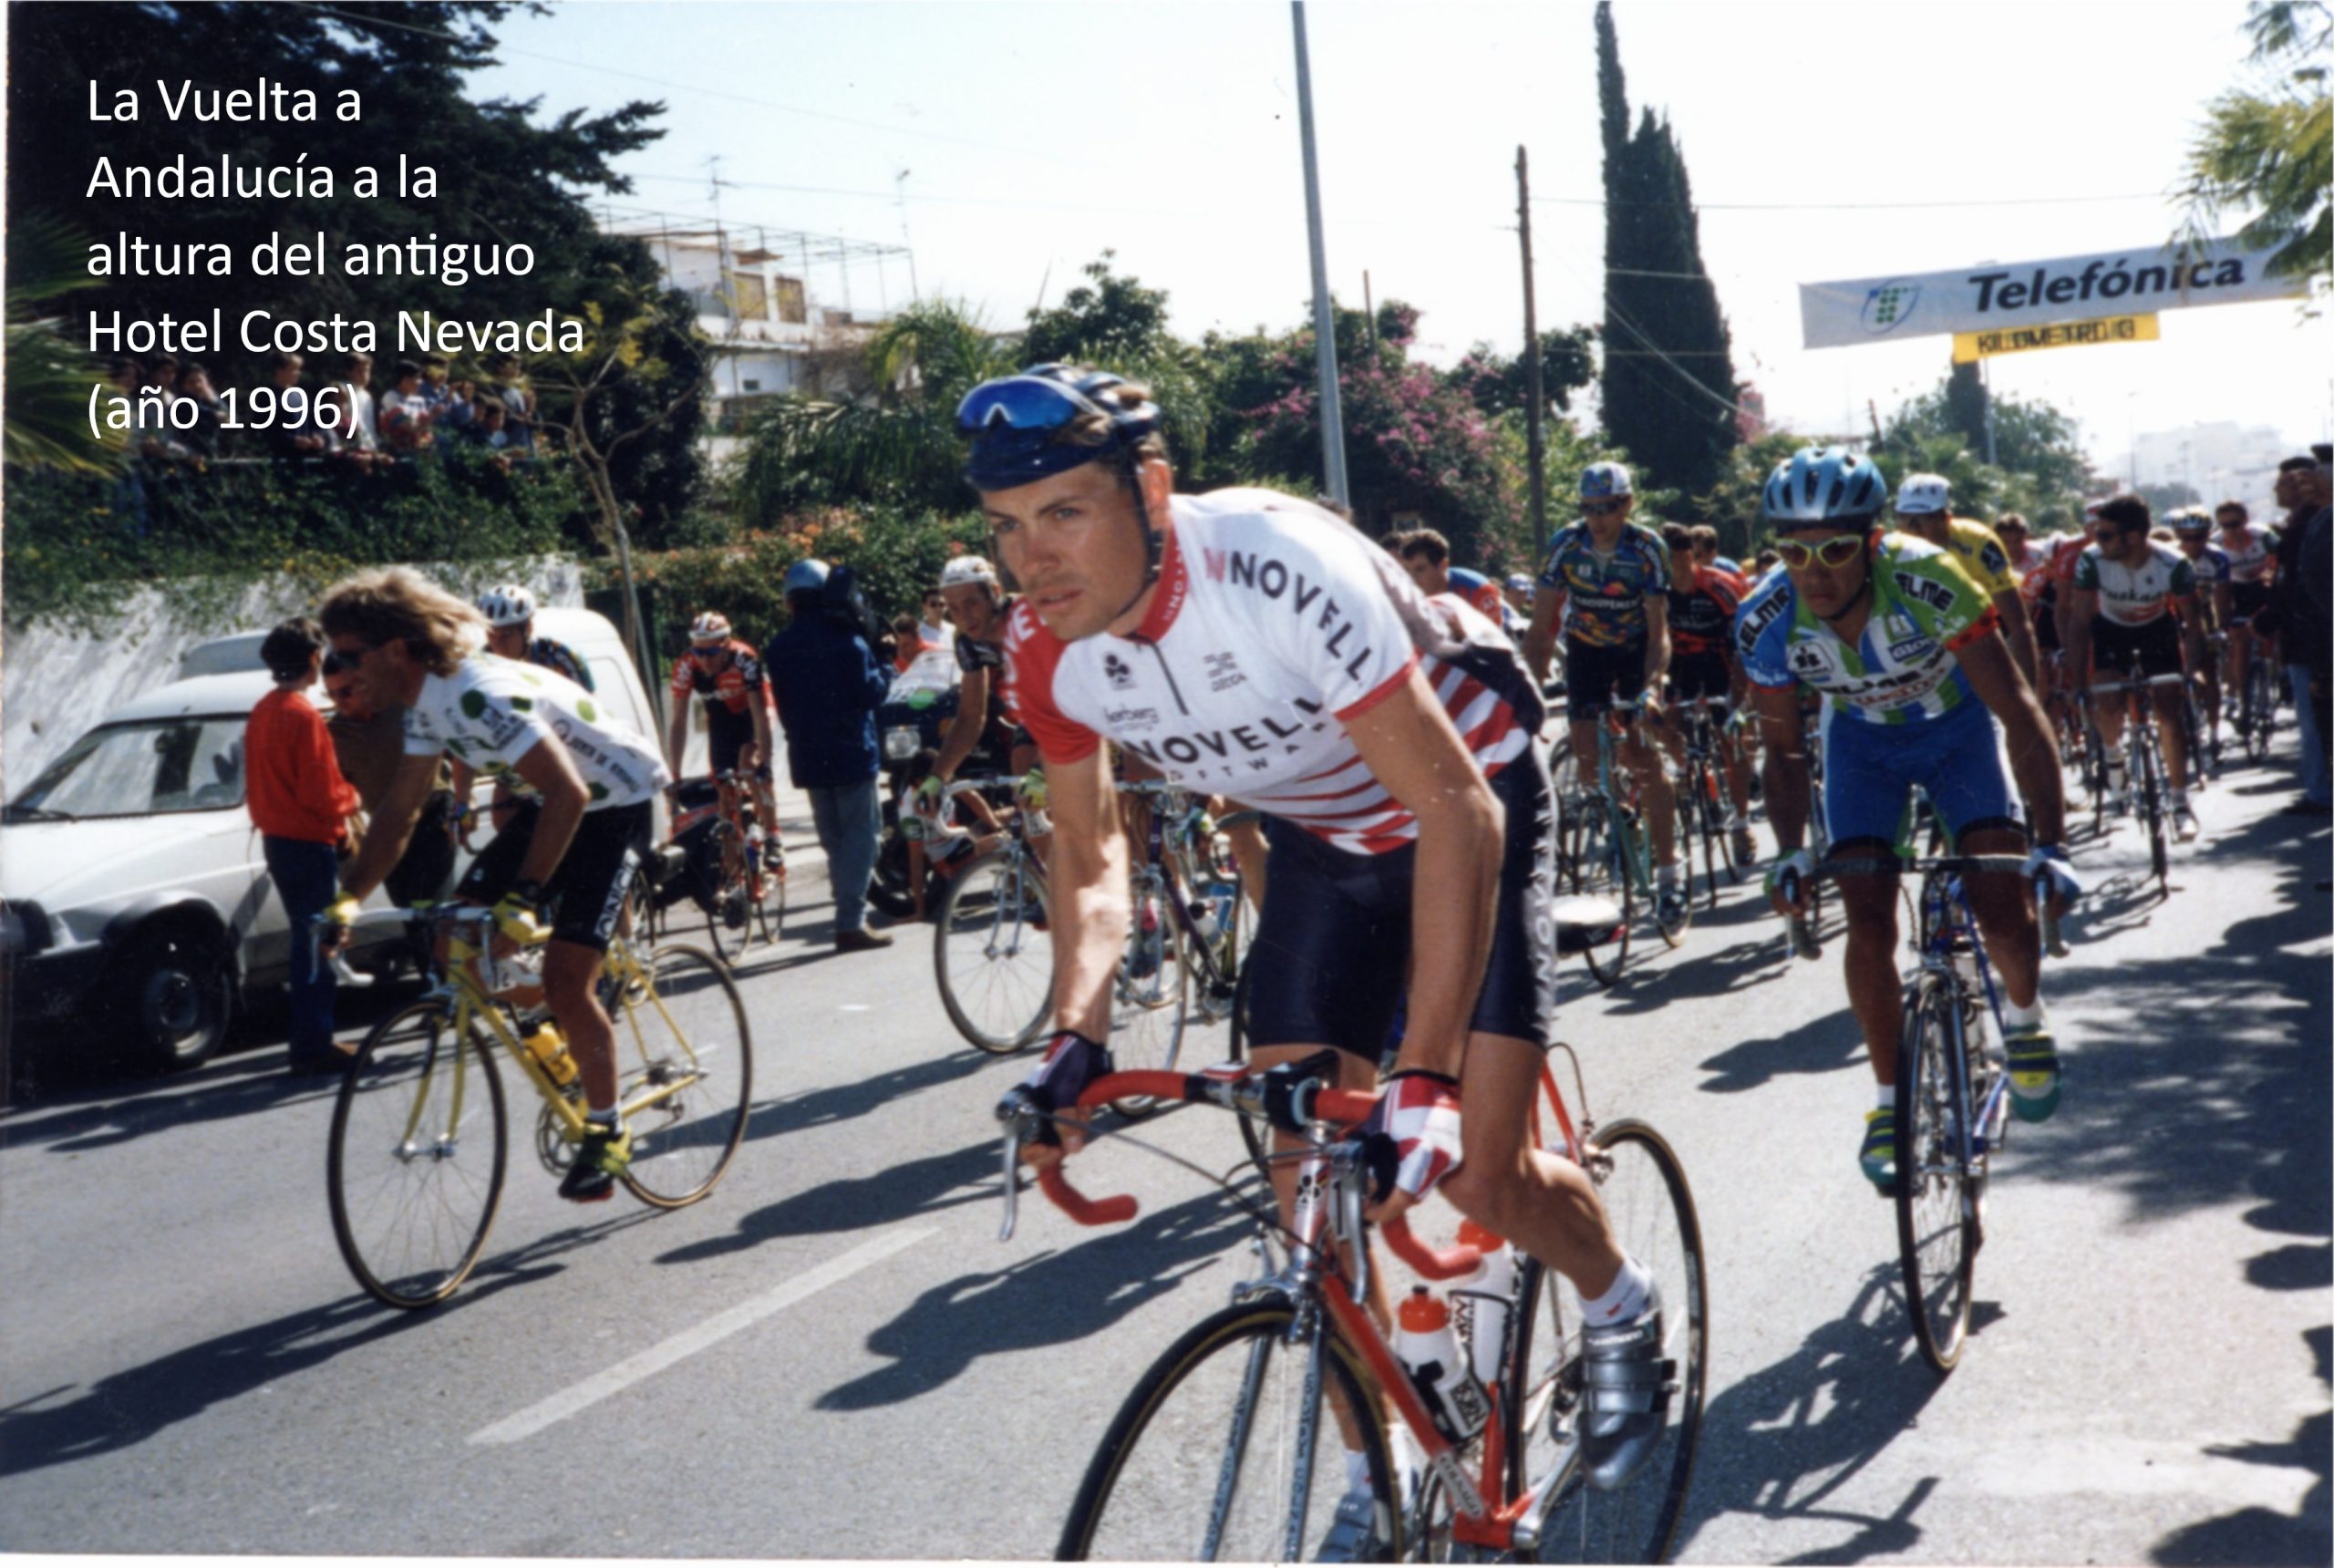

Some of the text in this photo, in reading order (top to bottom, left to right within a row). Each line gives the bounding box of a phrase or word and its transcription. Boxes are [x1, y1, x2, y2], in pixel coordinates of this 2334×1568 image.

[1968, 251, 2246, 312] Telefónica
[1231, 550, 1372, 682] NOVELL
[1122, 696, 1324, 764] NOVELL
